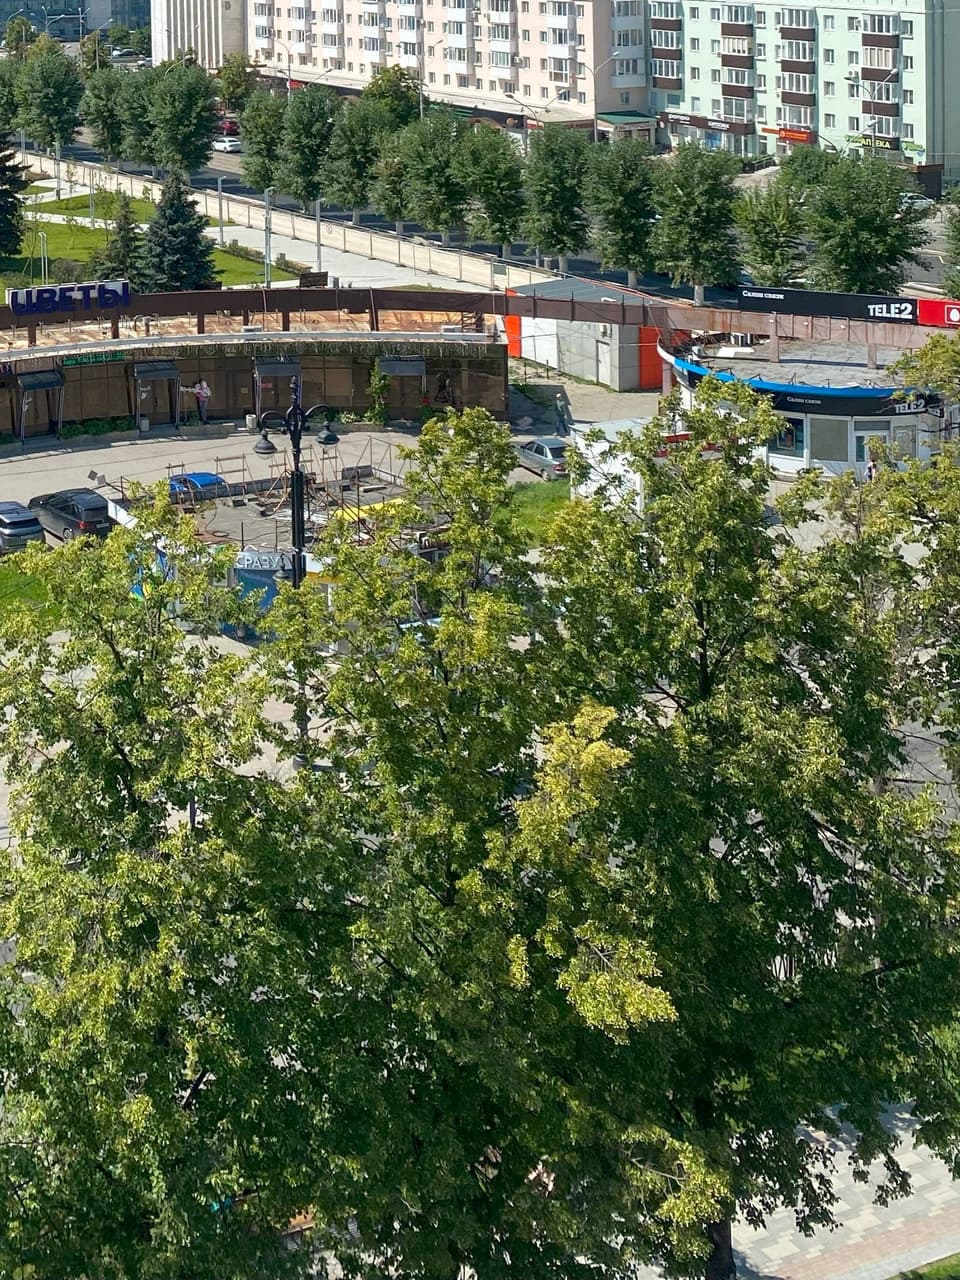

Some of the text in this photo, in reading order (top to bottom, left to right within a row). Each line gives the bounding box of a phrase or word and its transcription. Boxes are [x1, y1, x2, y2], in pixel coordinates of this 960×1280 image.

[861, 137, 891, 149] АПЕКА
[10, 280, 130, 316] ЦВЕТЫ
[867, 303, 913, 319] TELE2
[895, 399, 926, 414] TELE2
